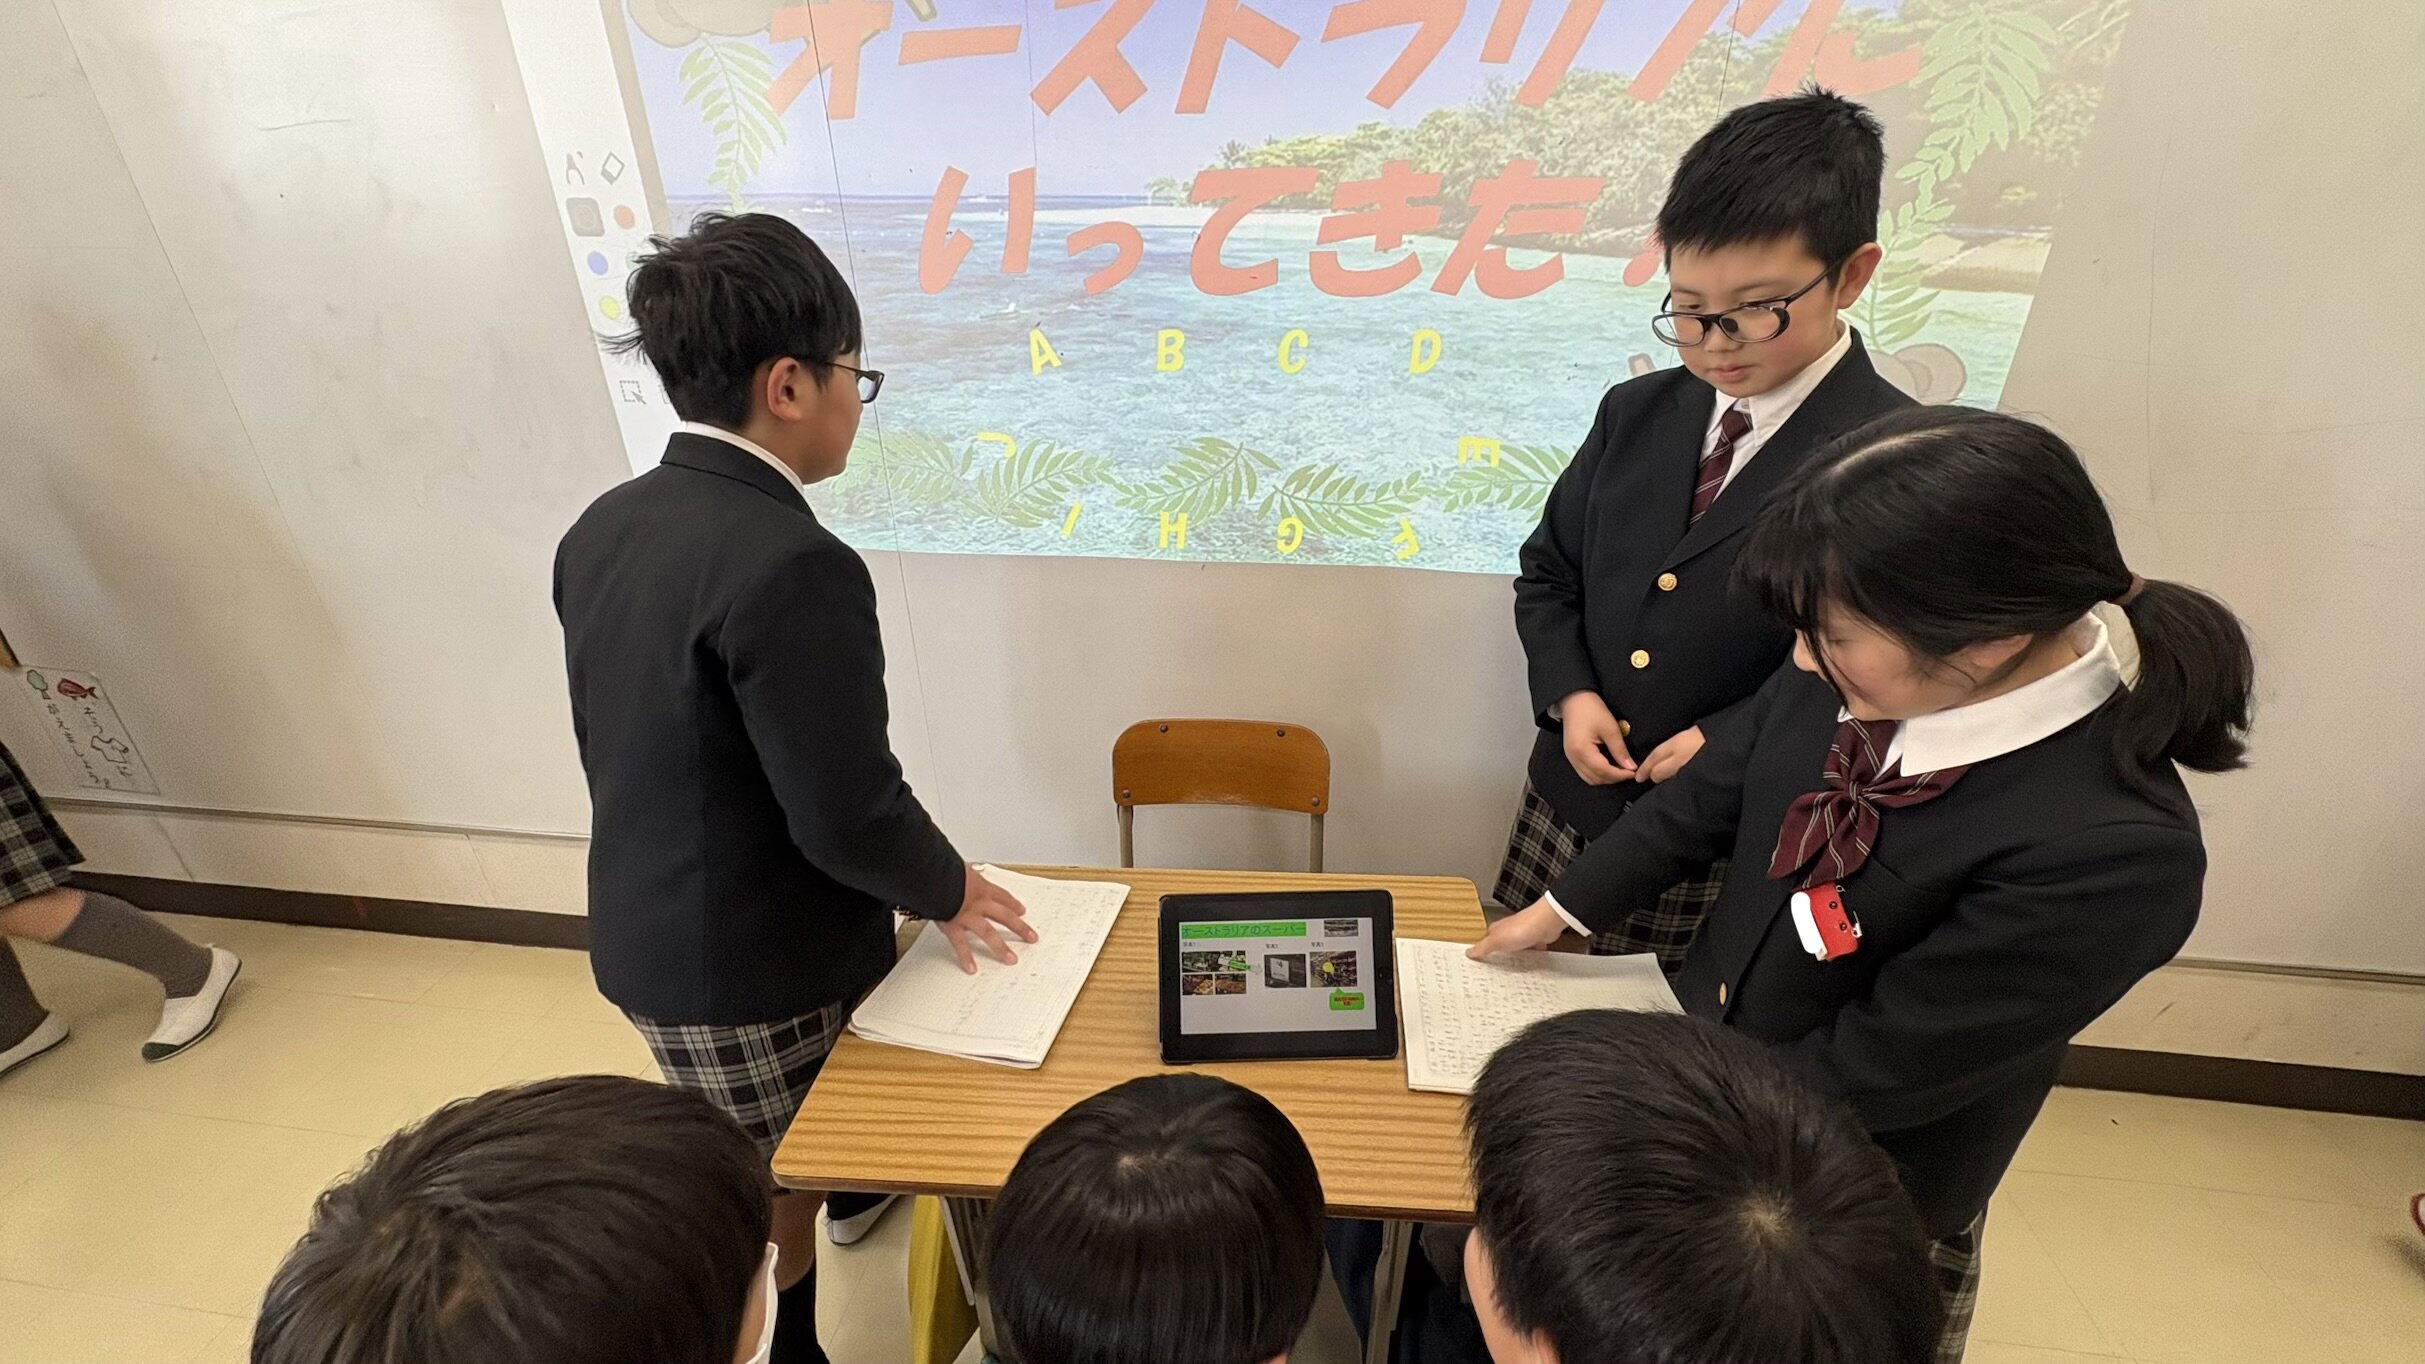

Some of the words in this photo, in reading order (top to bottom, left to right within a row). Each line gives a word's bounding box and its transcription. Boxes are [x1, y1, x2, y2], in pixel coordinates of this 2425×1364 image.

[1029, 328, 1062, 375] A
[1156, 328, 1185, 372] B
[1277, 329, 1309, 373] C
[1409, 328, 1443, 374] D
[1458, 436, 1500, 467] E
[1158, 511, 1187, 550] H
[1276, 517, 1303, 554] G
[1392, 519, 1419, 560] F
[1182, 924, 1306, 937] オーストラリアのスーパー
